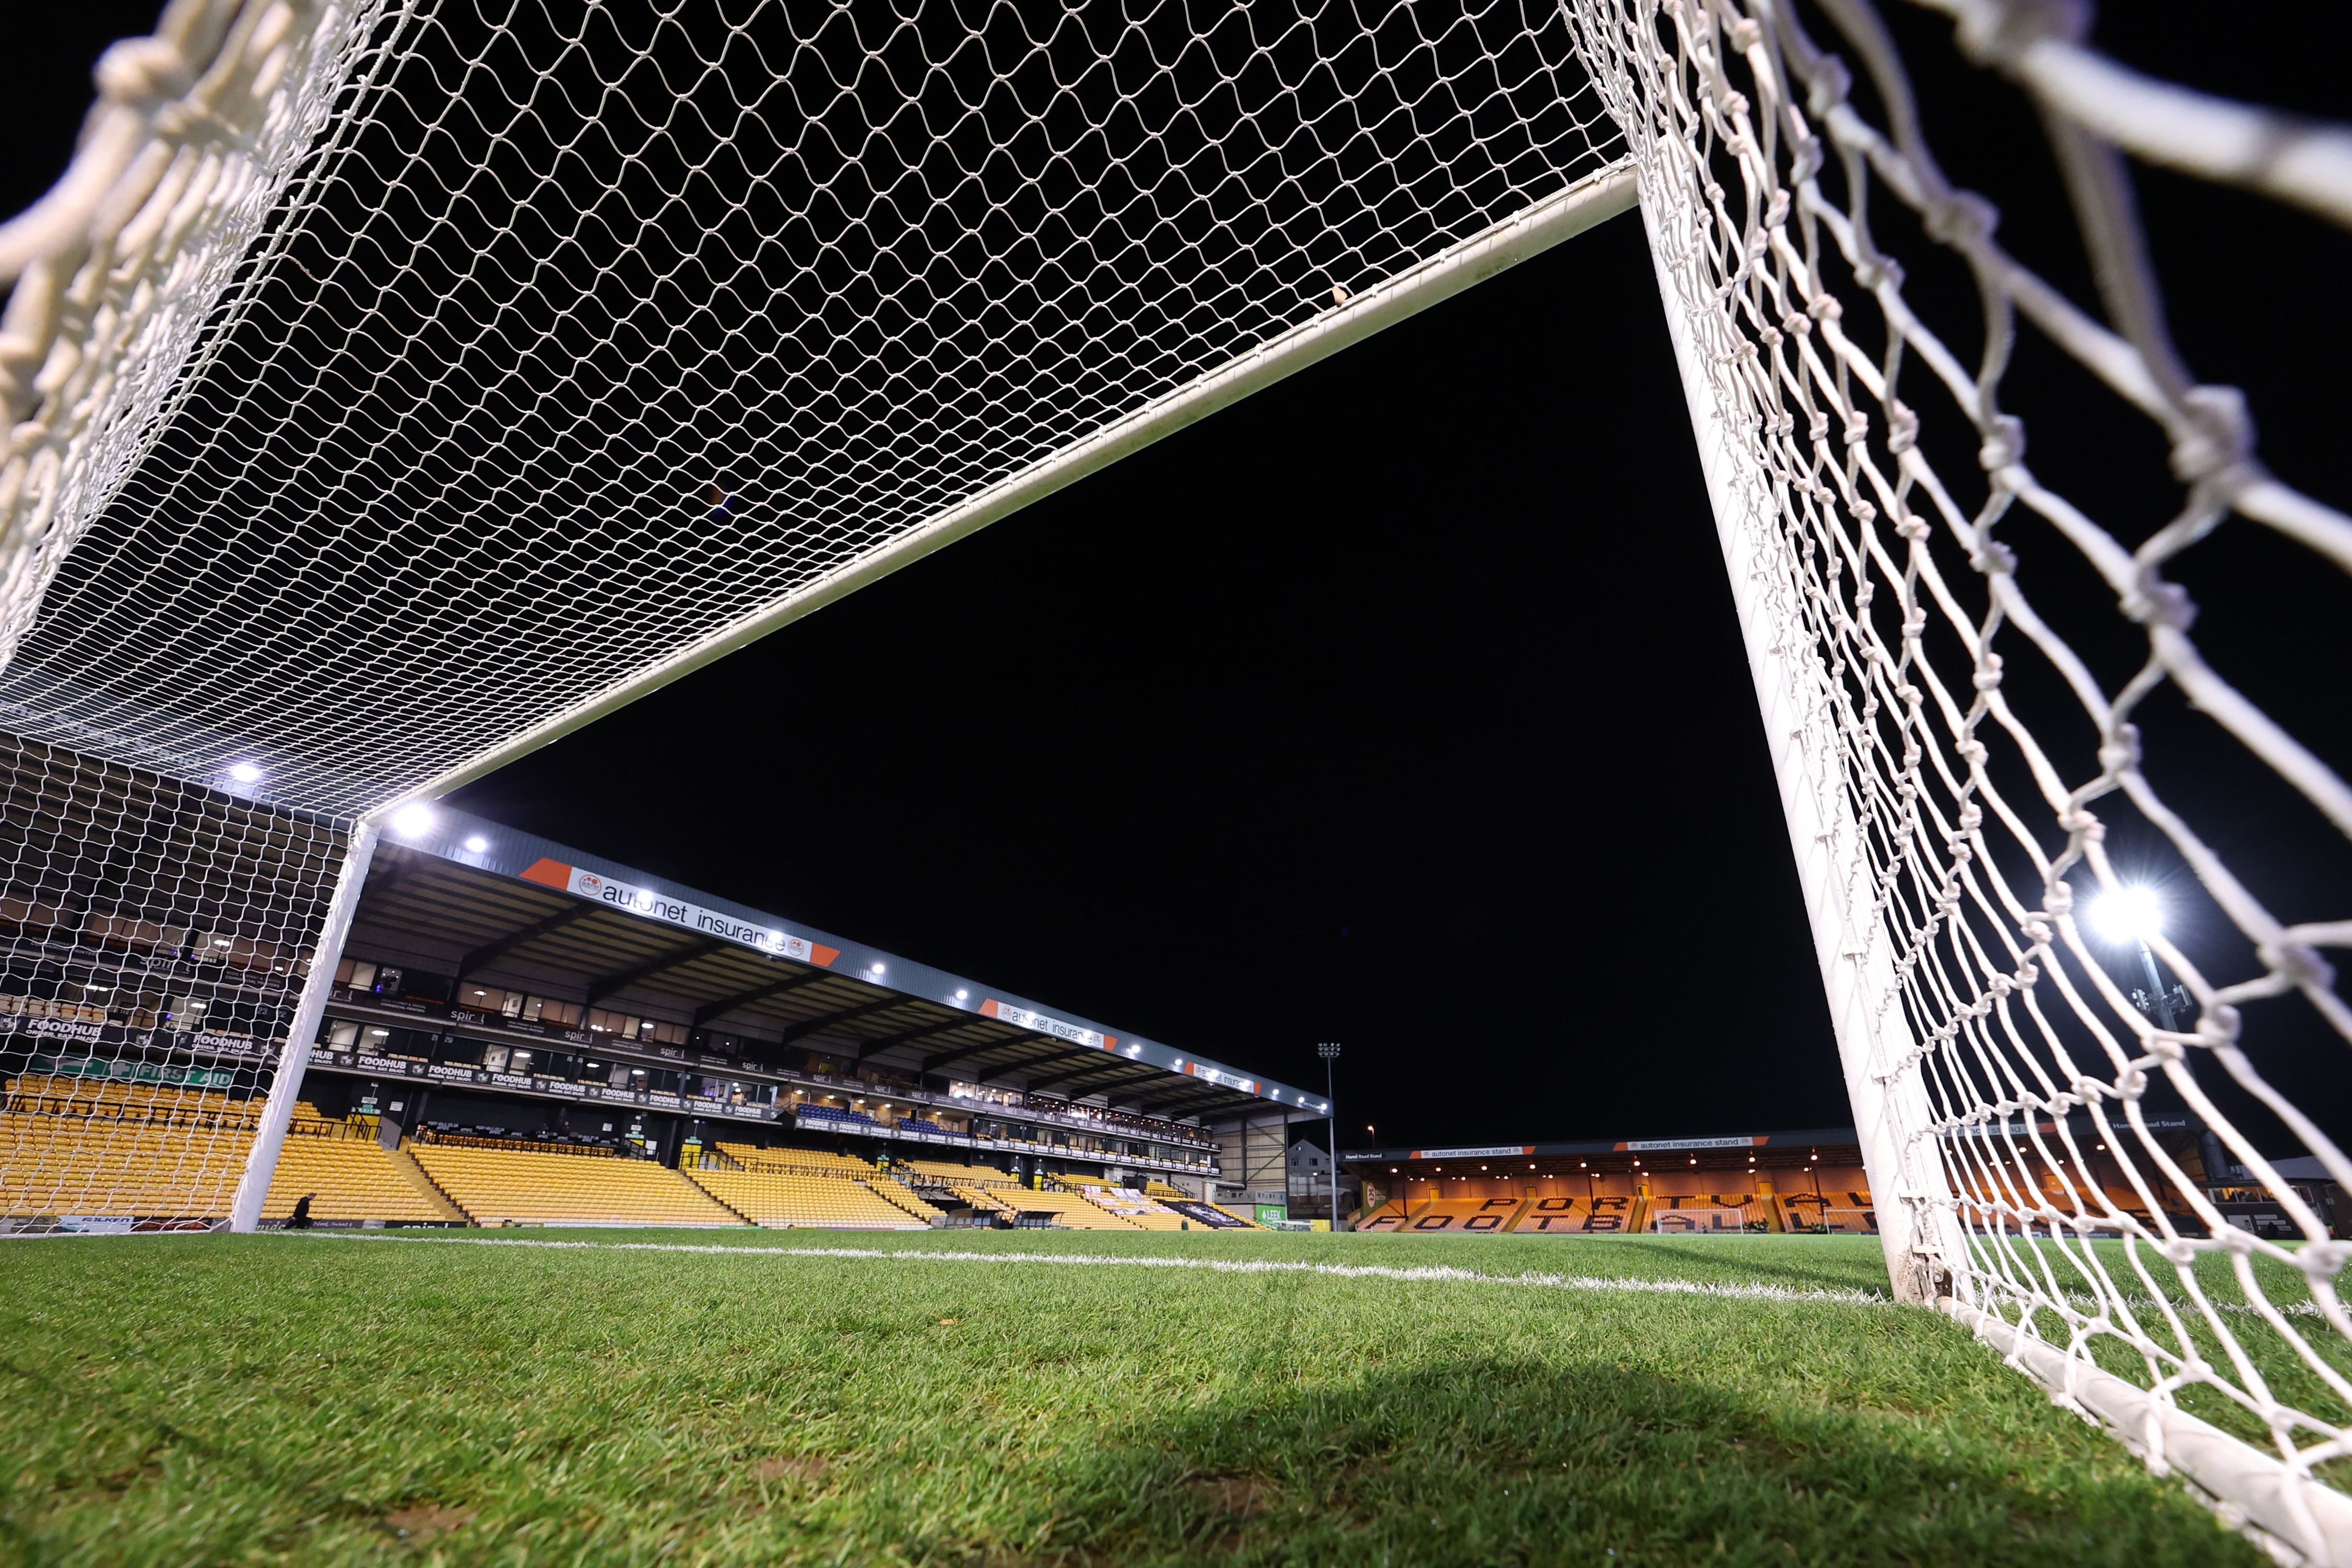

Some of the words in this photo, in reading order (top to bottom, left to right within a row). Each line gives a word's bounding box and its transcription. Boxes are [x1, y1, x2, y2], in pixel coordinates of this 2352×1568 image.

[139, 956, 190, 972] spirl
[451, 1010, 484, 1023] spirl
[28, 1019, 102, 1037] FOODHUB
[1053, 1021, 1092, 1043] insurane
[565, 1030, 593, 1042] spirl
[193, 1035, 254, 1050] FOODHUB
[660, 1047, 684, 1058] spirl
[358, 1055, 407, 1069] FOODHUB
[742, 1061, 763, 1072] spirl
[139, 1066, 196, 1080] FIRST
[199, 1071, 231, 1084] AID
[429, 1065, 472, 1077] FOODHUB
[492, 1073, 531, 1085] FOODHUB
[549, 1081, 585, 1092] FOODHUB
[602, 1088, 635, 1099] FOODHUB
[649, 1095, 680, 1104] FOODHUB
[694, 1100, 722, 1109] FOODHUB
[735, 1106, 761, 1114] FOODHUB
[805, 1119, 829, 1127] FOODHUB
[1711, 1192, 1874, 1208] VAL
[1267, 1209, 1281, 1220] LEEK
